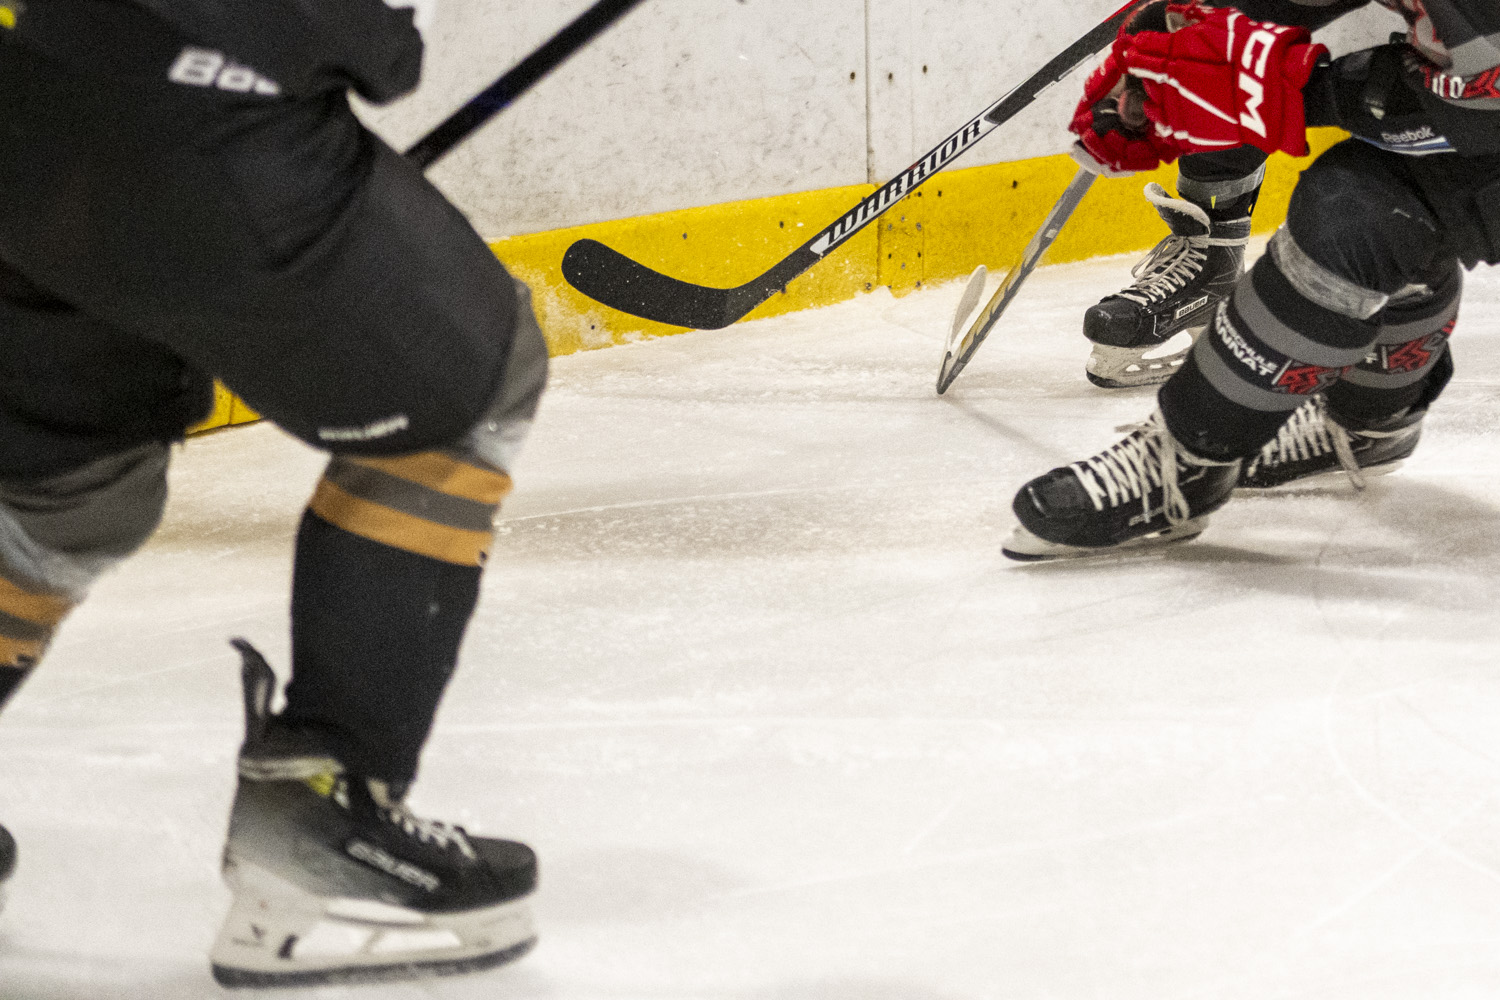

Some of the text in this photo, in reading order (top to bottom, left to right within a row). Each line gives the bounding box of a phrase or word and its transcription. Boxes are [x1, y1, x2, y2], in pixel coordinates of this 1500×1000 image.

[1238, 23, 1283, 138] CM
[1381, 125, 1434, 144] Reebok
[828, 117, 981, 244] WARRIOR
